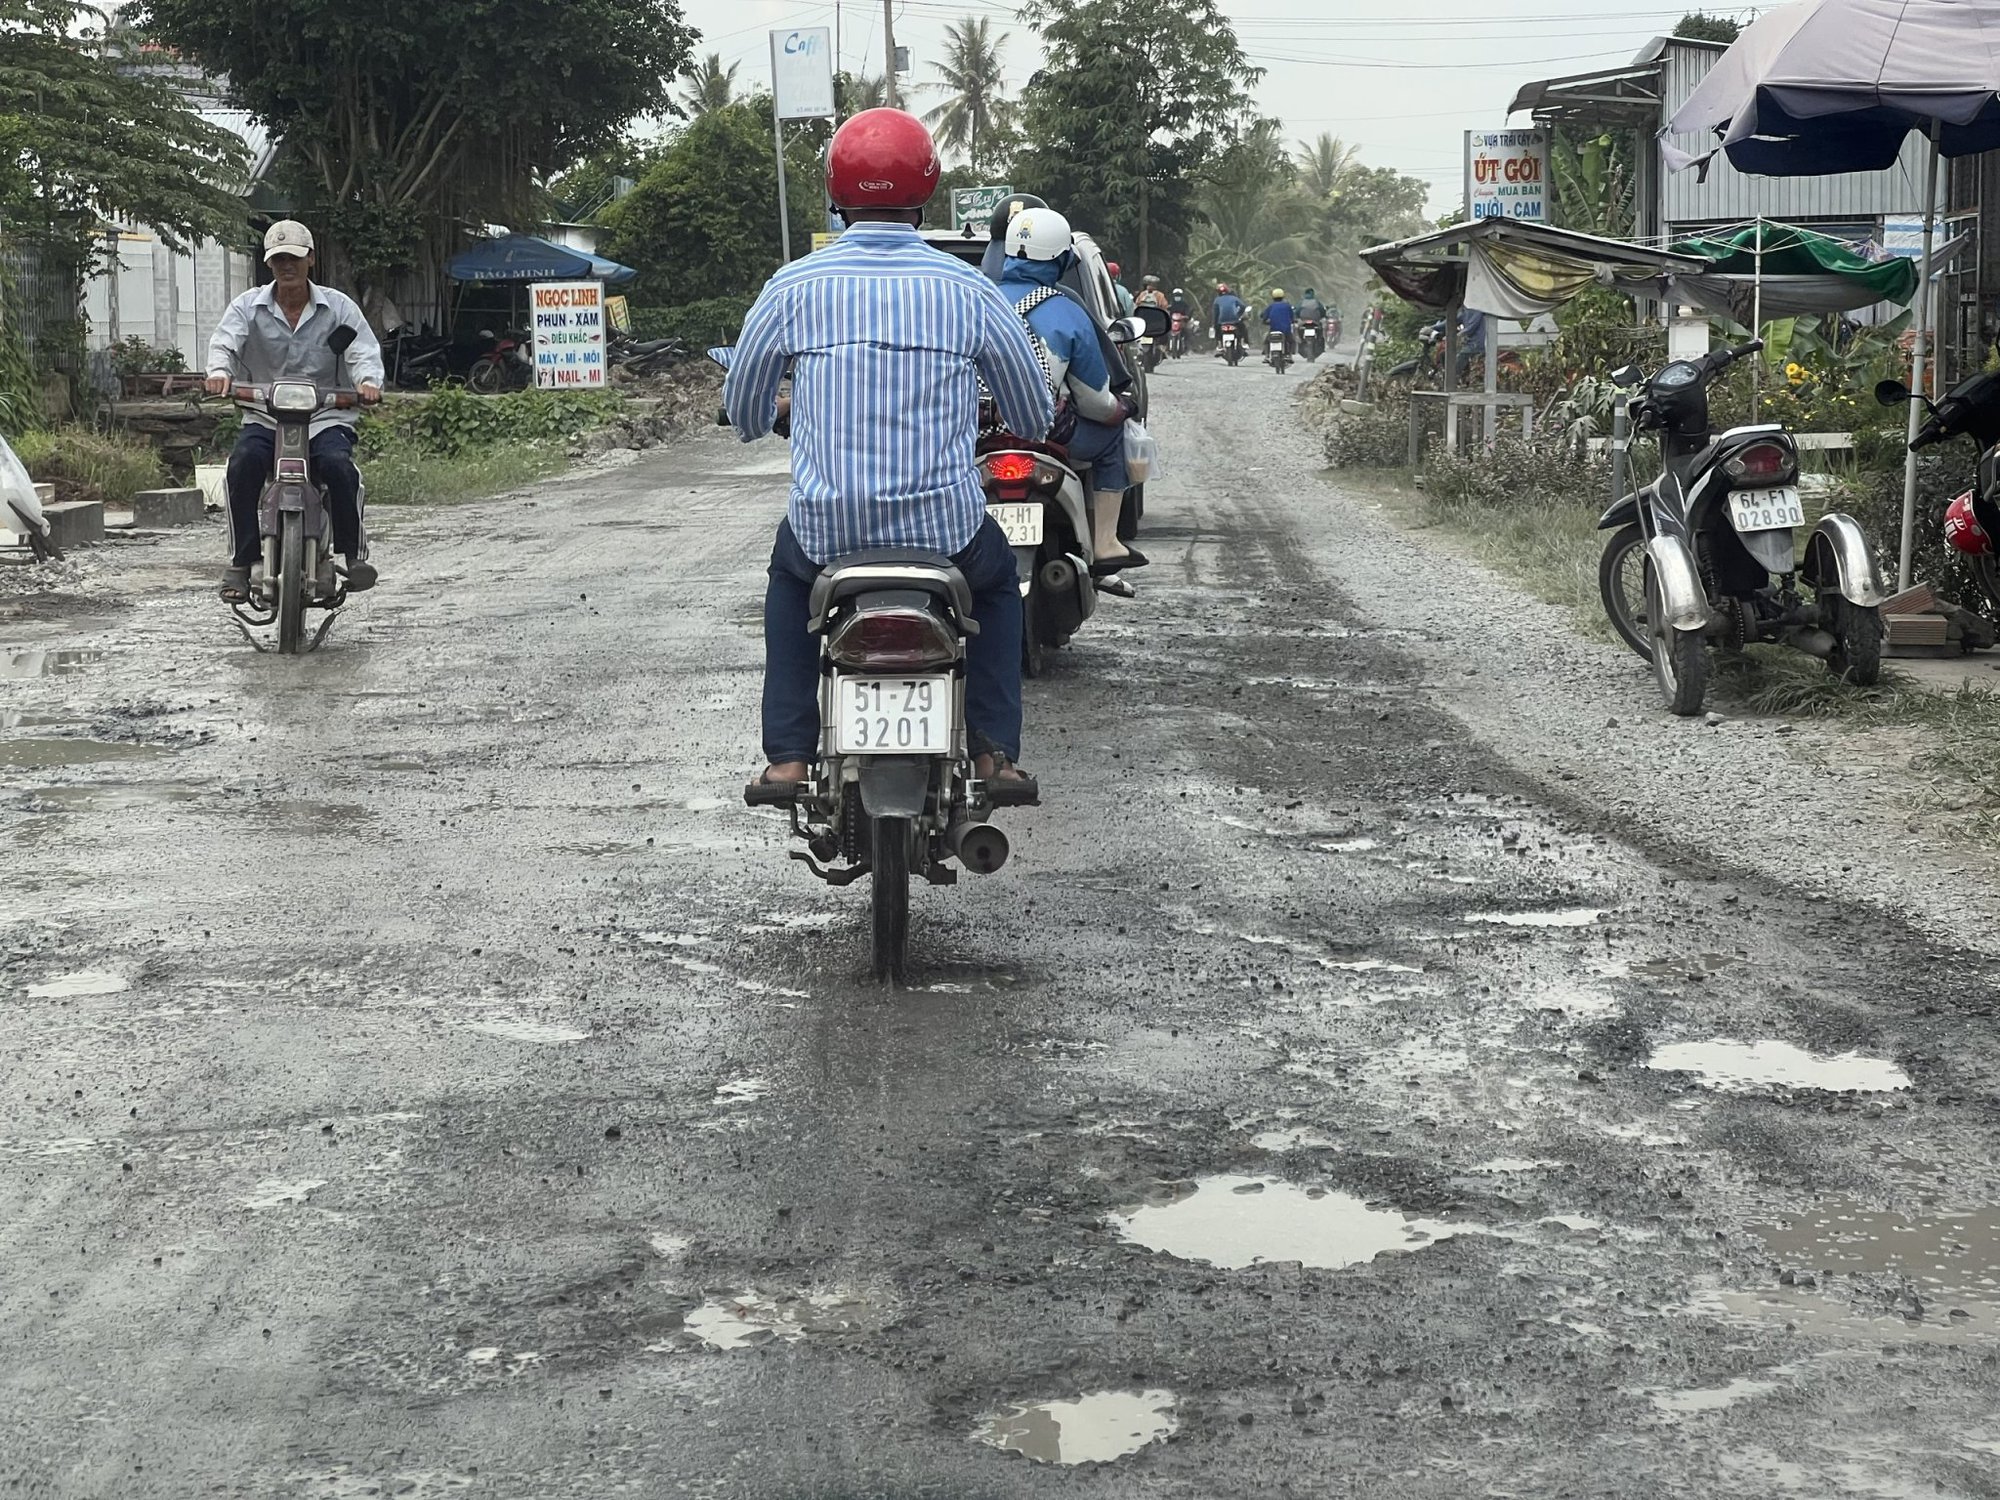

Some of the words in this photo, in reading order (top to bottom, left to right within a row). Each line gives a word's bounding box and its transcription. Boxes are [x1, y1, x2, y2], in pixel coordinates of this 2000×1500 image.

[1500, 132, 1516, 146] TRÁI
[1498, 186, 1519, 196] MUA
[1514, 202, 1541, 217] CAM
[512, 269, 556, 278] MINH
[536, 289, 569, 311] NGỌC
[571, 289, 598, 306] LINH
[537, 313, 566, 327] PHUN
[576, 308, 598, 326] XĂM
[558, 370, 581, 383] NAIL
[589, 369, 600, 383] MI
[1738, 507, 1801, 529] 028.90
[855, 717, 929, 747] 3201
